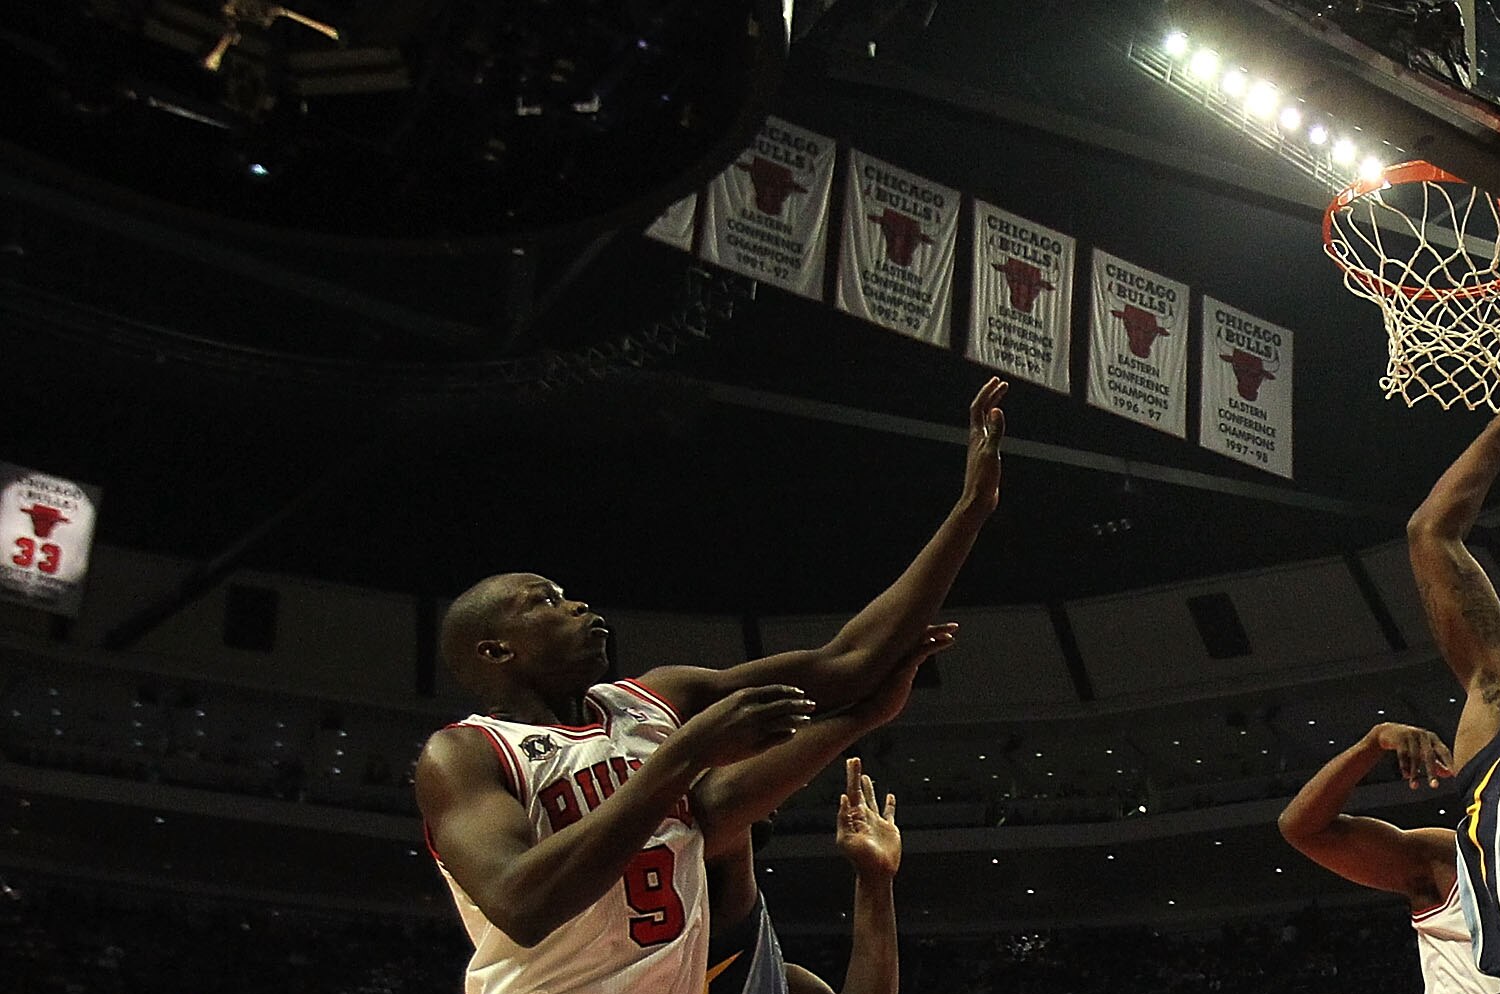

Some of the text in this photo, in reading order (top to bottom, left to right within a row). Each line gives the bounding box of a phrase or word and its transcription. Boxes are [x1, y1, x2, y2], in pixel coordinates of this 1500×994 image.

[757, 141, 806, 169] ULLS
[864, 166, 943, 208] CHICAGO
[876, 189, 933, 221] BULLS
[987, 215, 1062, 256] CHICAGO
[727, 233, 802, 270] CHAMPIONS
[999, 237, 1052, 268] BULLS
[1106, 264, 1176, 303] CHICAGO
[1116, 284, 1166, 315] BULLS
[988, 317, 1054, 349] CONFERENCE
[999, 306, 1042, 329] EASTERN
[1215, 310, 1281, 347] CHICAGO
[988, 332, 1052, 363] CHAMPIONS
[1226, 330, 1273, 358] BULLS
[1118, 353, 1160, 378] EASTERN
[1108, 366, 1170, 397] CONFERENCE
[1108, 380, 1169, 410] CHAMPIONS
[1218, 409, 1276, 436] CONFERENCE
[1229, 398, 1267, 420] EASTERN
[1219, 423, 1276, 451] CHAMPIONS
[13, 537, 60, 574] 33
[623, 844, 686, 948] 9
